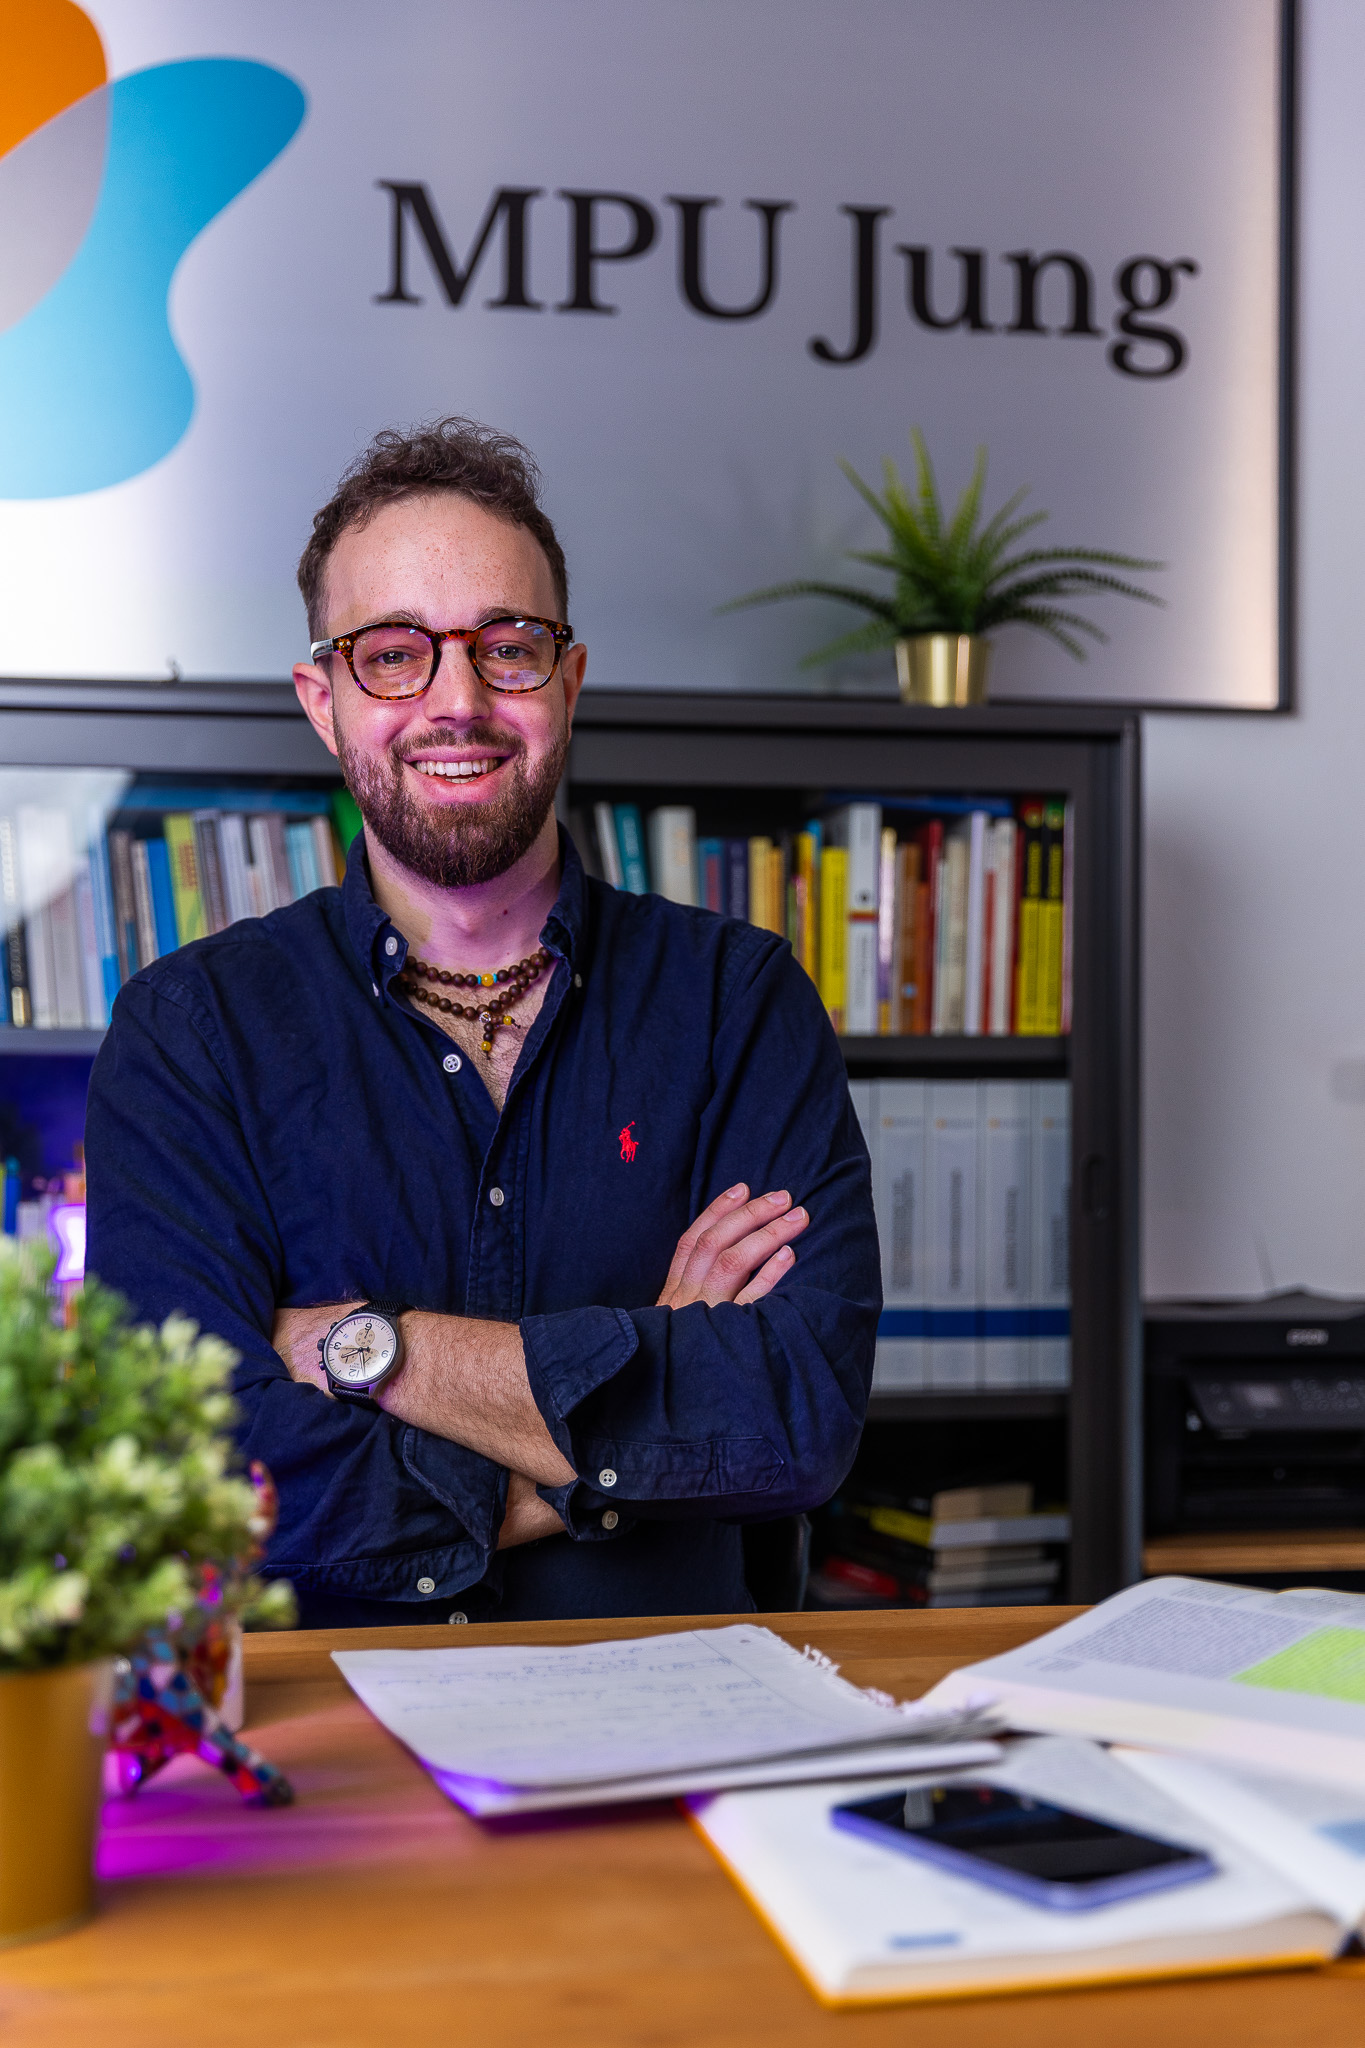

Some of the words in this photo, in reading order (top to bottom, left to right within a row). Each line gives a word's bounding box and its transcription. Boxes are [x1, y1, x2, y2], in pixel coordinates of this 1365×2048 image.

[375, 178, 796, 322] MPU
[807, 203, 1199, 380] Jung
[333, 1342, 341, 1350] 3
[349, 1368, 360, 1378] 12
